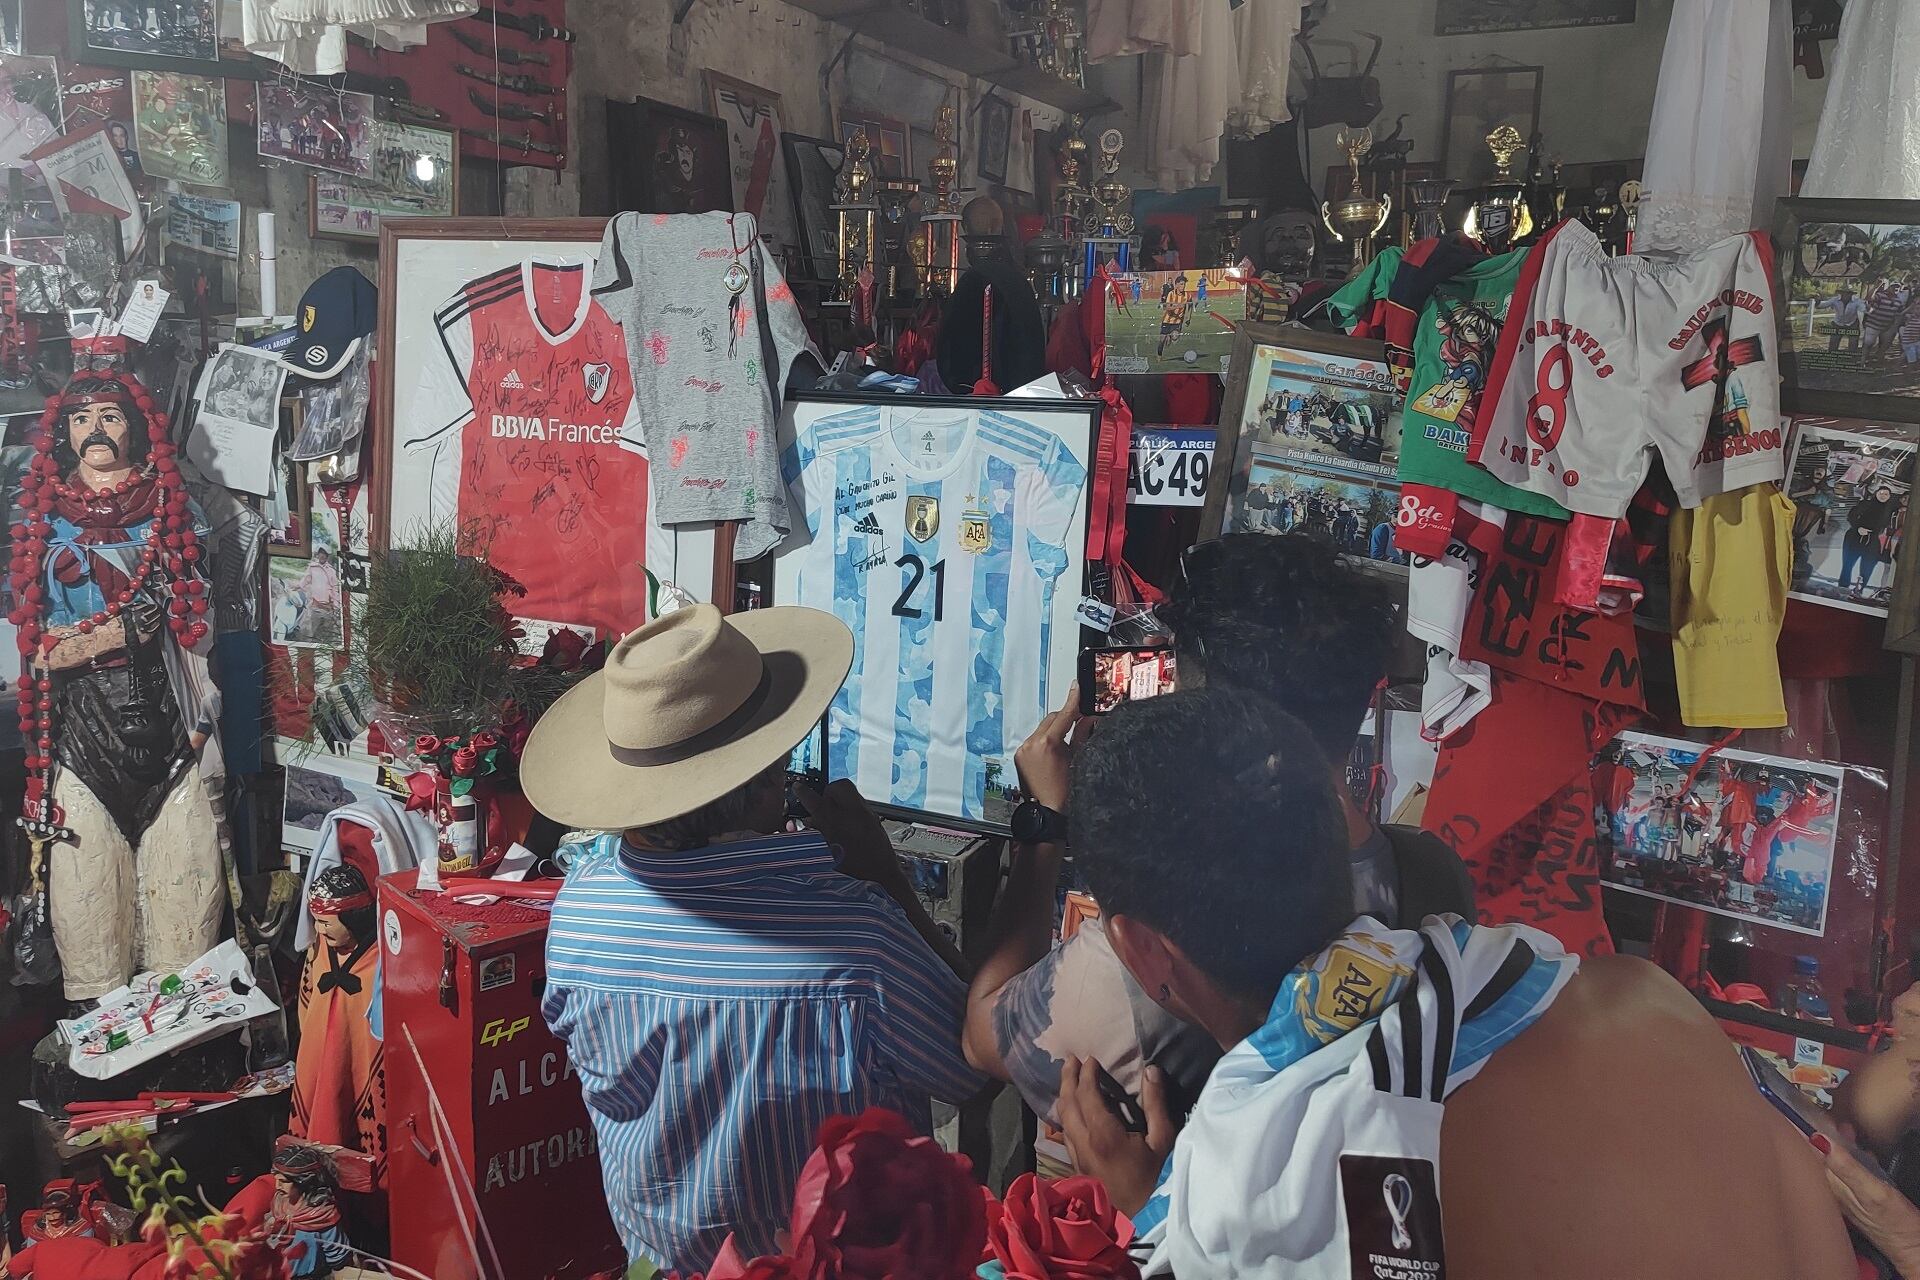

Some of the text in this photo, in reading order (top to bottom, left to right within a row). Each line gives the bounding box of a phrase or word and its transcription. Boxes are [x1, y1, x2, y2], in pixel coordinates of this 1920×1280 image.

[63, 78, 125, 95] ORES
[500, 380, 525, 390] adidas
[1525, 343, 1574, 453] 8
[491, 414, 624, 445] BBVA Francés
[1423, 424, 1471, 446] BAK
[924, 442, 933, 453] 4
[1397, 495, 1421, 527] 8
[853, 524, 884, 536] adidas
[965, 521, 986, 543] AFA
[891, 553, 946, 623] 21
[1332, 962, 1383, 1021] AFA
[1368, 1253, 1441, 1272] FIFA WORLD CUP
